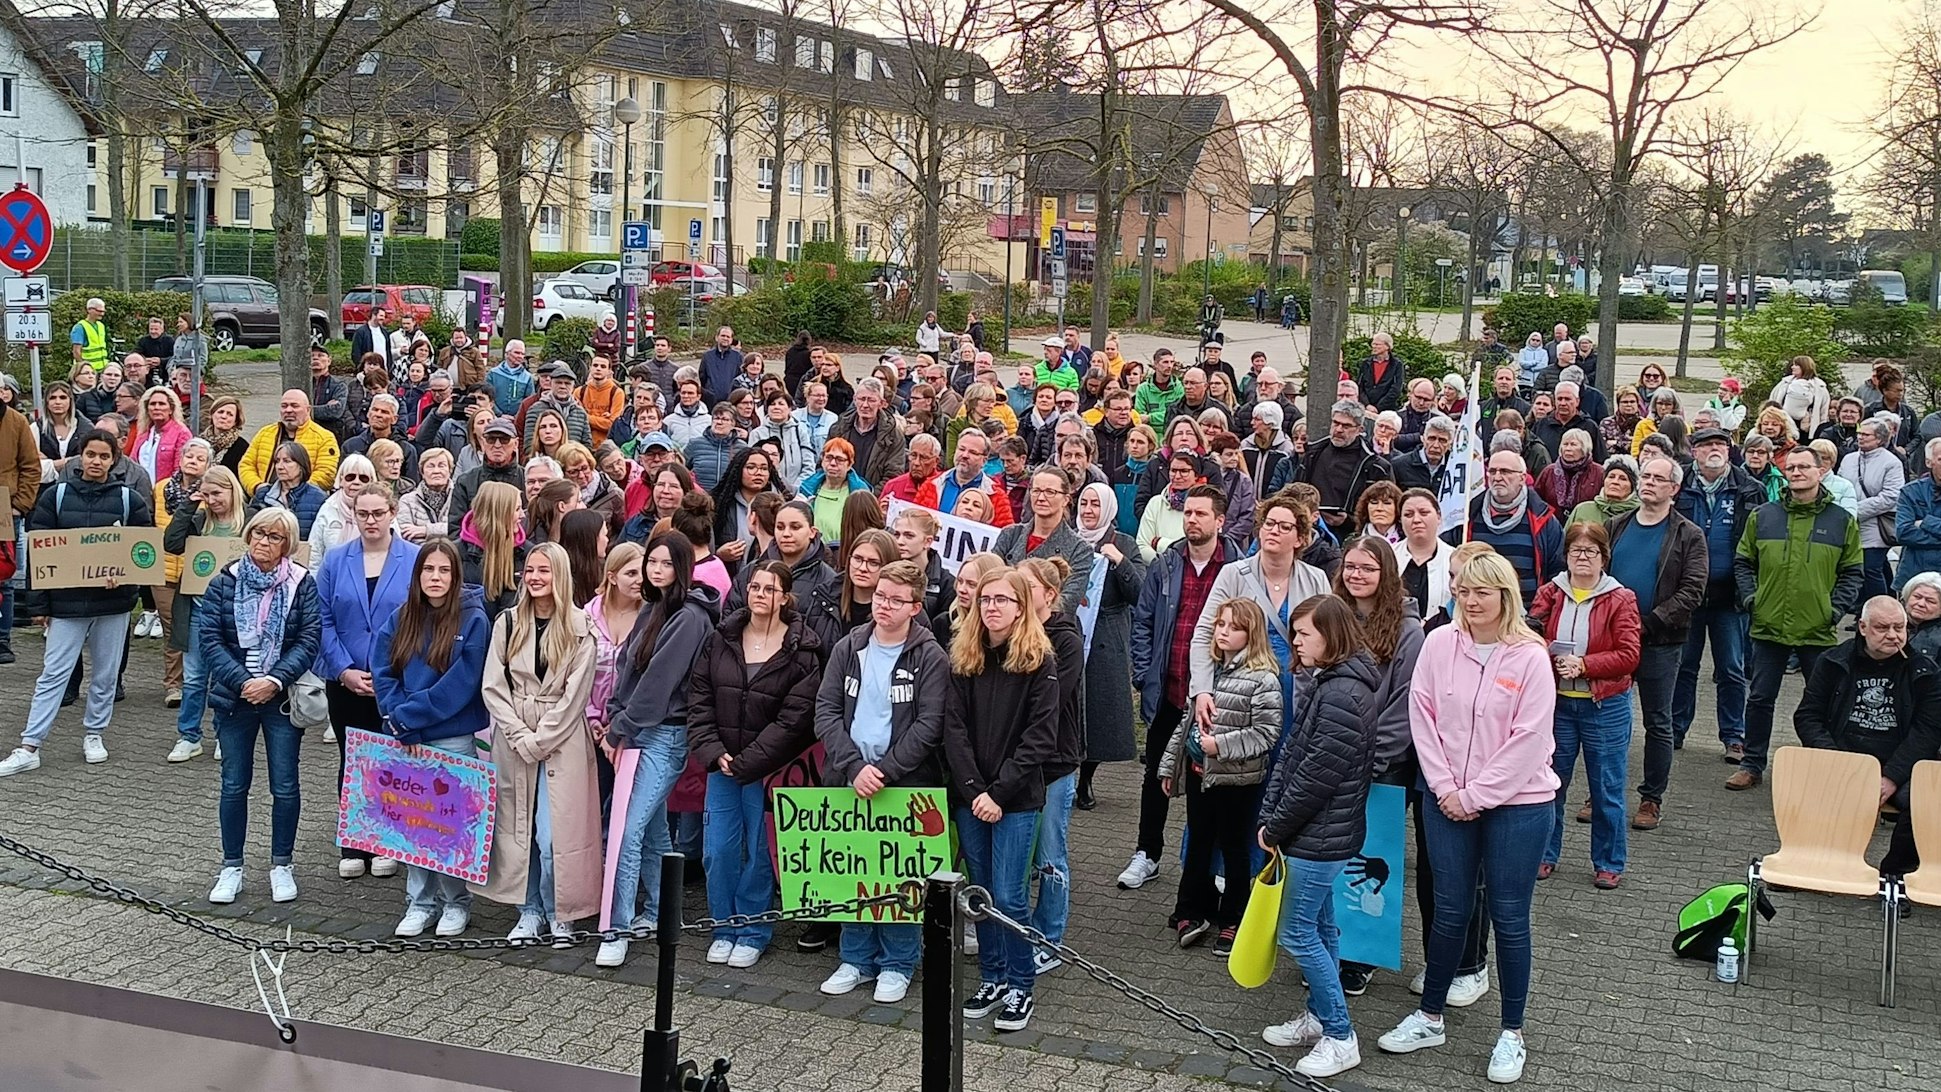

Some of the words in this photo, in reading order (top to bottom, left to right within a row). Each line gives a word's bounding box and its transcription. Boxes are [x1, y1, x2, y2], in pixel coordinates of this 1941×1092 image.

[627, 226, 641, 246] P
[18, 314, 39, 325] 20.3.
[15, 329, 26, 339] ab
[33, 536, 67, 549] KEIN
[80, 532, 121, 545] MENSCH
[36, 565, 58, 580] IST
[82, 565, 126, 580] ILLEGAL
[378, 770, 428, 796] Jeder
[381, 804, 402, 821] hier
[440, 802, 457, 817] ist
[777, 793, 916, 833] Deutschland
[782, 838, 812, 874] ist
[819, 837, 868, 876] kein
[880, 840, 944, 879] Platz
[857, 881, 924, 922] NAZI
